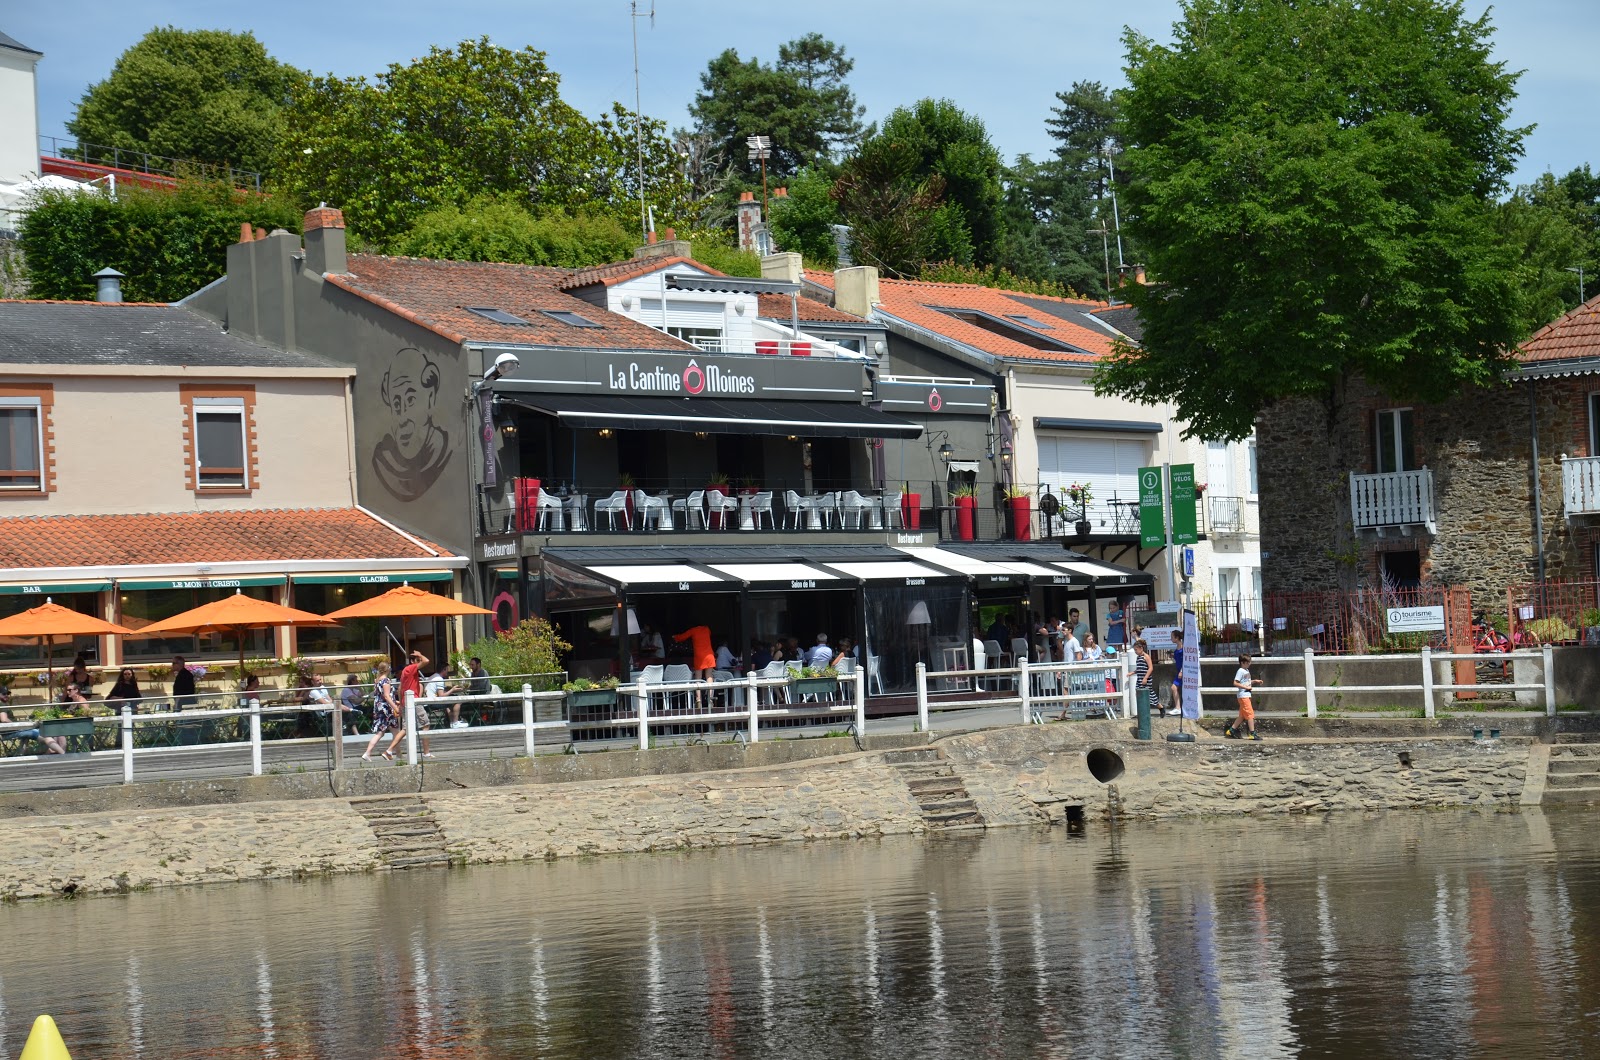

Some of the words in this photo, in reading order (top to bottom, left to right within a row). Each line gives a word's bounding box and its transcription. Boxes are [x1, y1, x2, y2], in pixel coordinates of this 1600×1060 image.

[609, 364, 627, 390] La
[629, 362, 681, 392] Cantine
[706, 365, 755, 394] Moines
[1173, 475, 1191, 483] VÉLOS
[897, 532, 923, 544] Restaurant
[484, 540, 516, 558] Restaurant
[359, 575, 389, 583] GLACES
[906, 577, 925, 586] Brasserie
[678, 581, 690, 591] Café
[791, 580, 802, 589] Salon
[803, 580, 808, 589] de
[23, 586, 42, 594] BAR
[1402, 610, 1432, 618] tourisme
